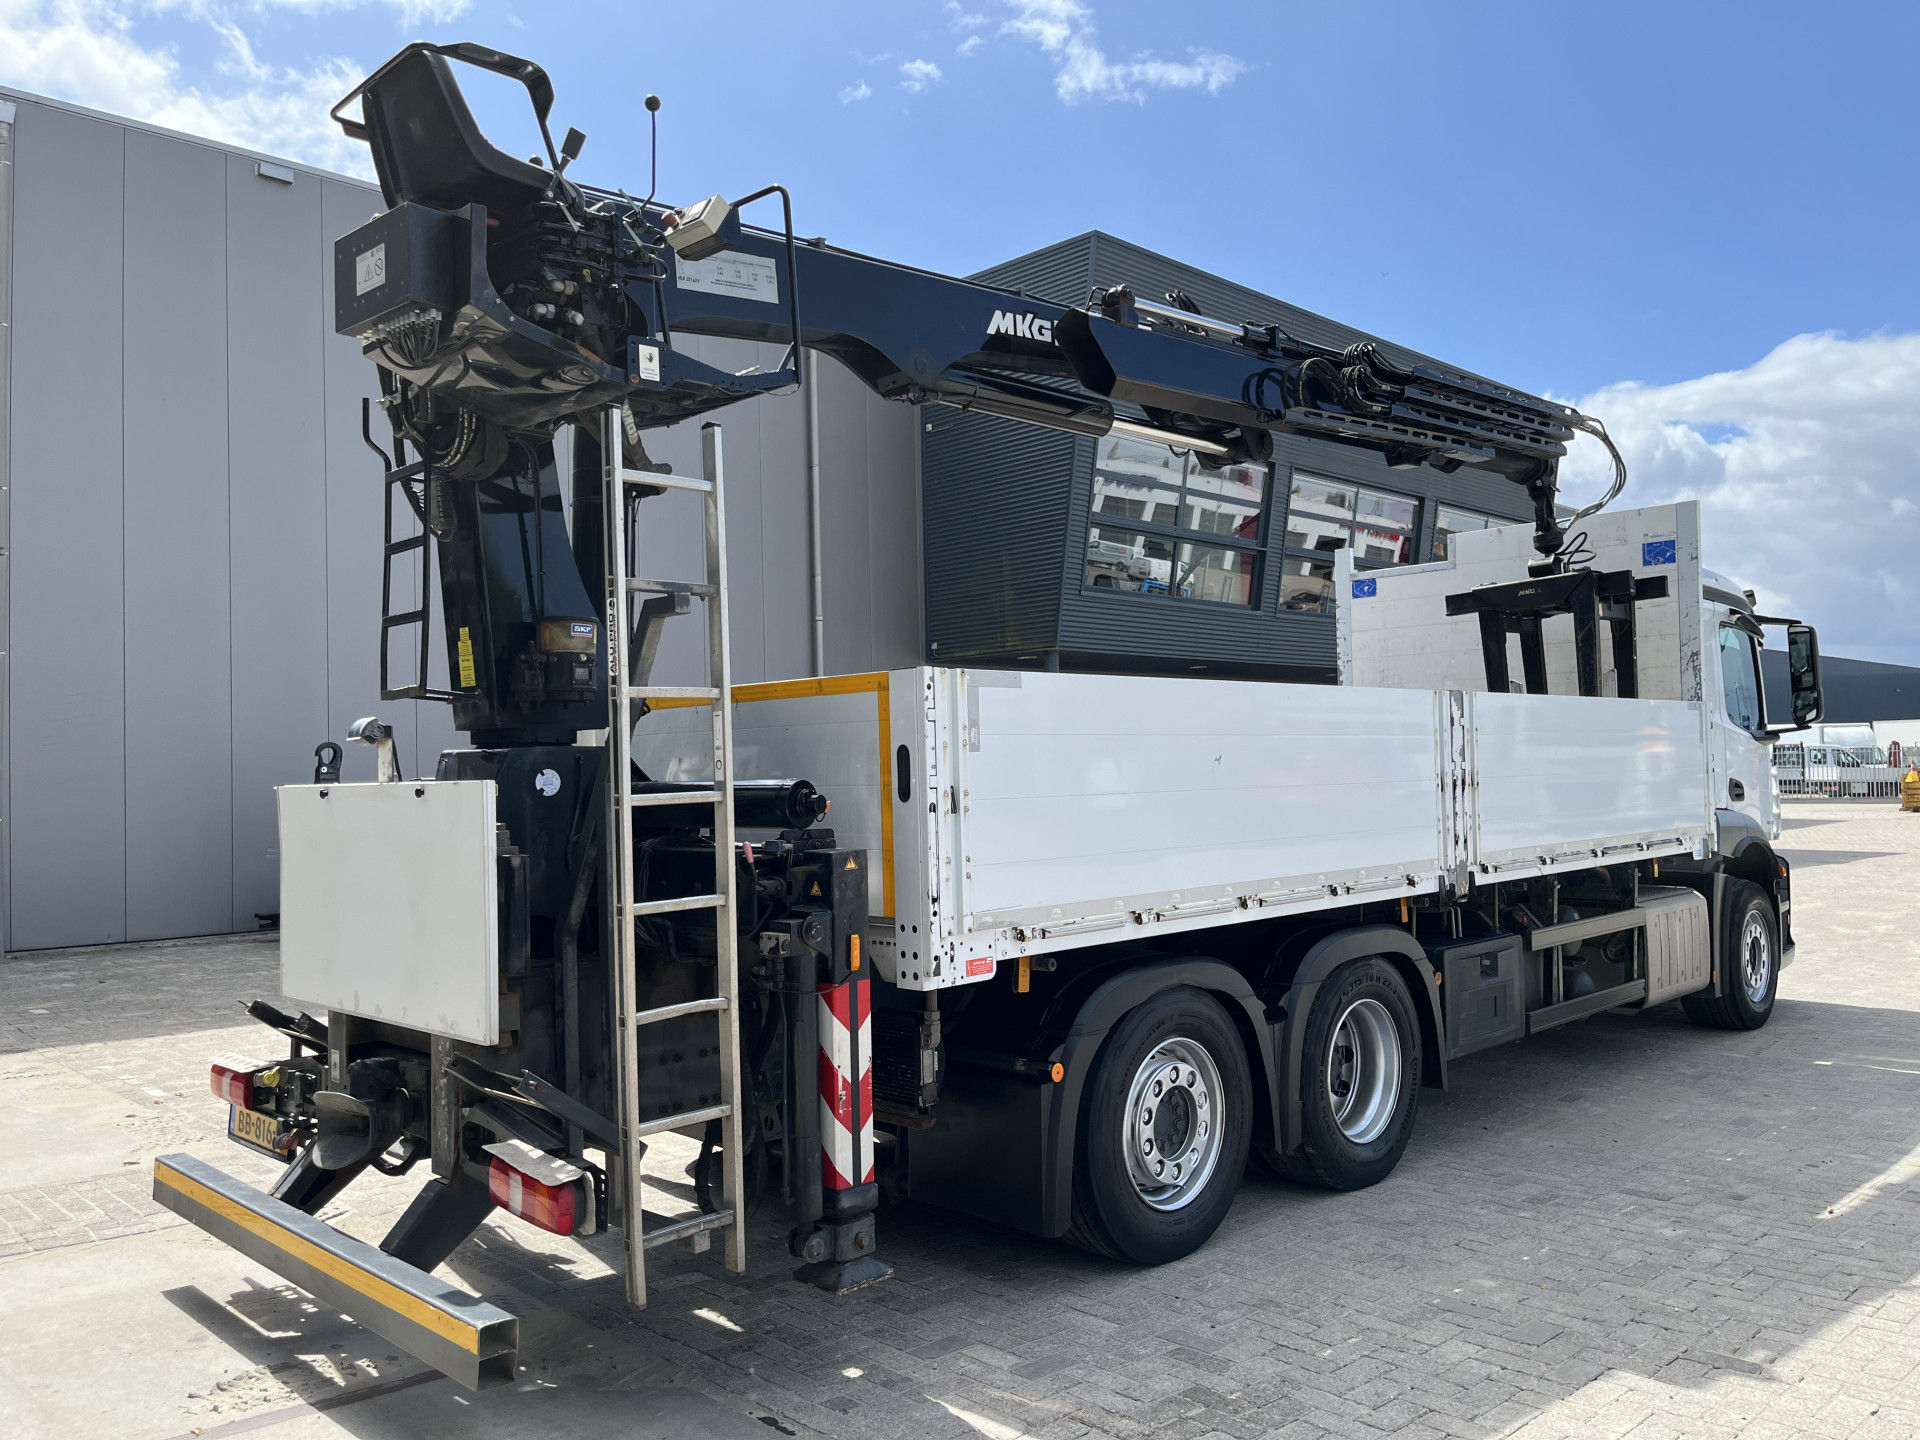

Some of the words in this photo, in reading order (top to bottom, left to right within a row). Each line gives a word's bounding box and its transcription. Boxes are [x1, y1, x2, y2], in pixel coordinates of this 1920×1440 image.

[573, 625, 592, 633] SKF
[1399, 1056, 1419, 1136] Continental
[237, 1110, 276, 1145] BB-816-
